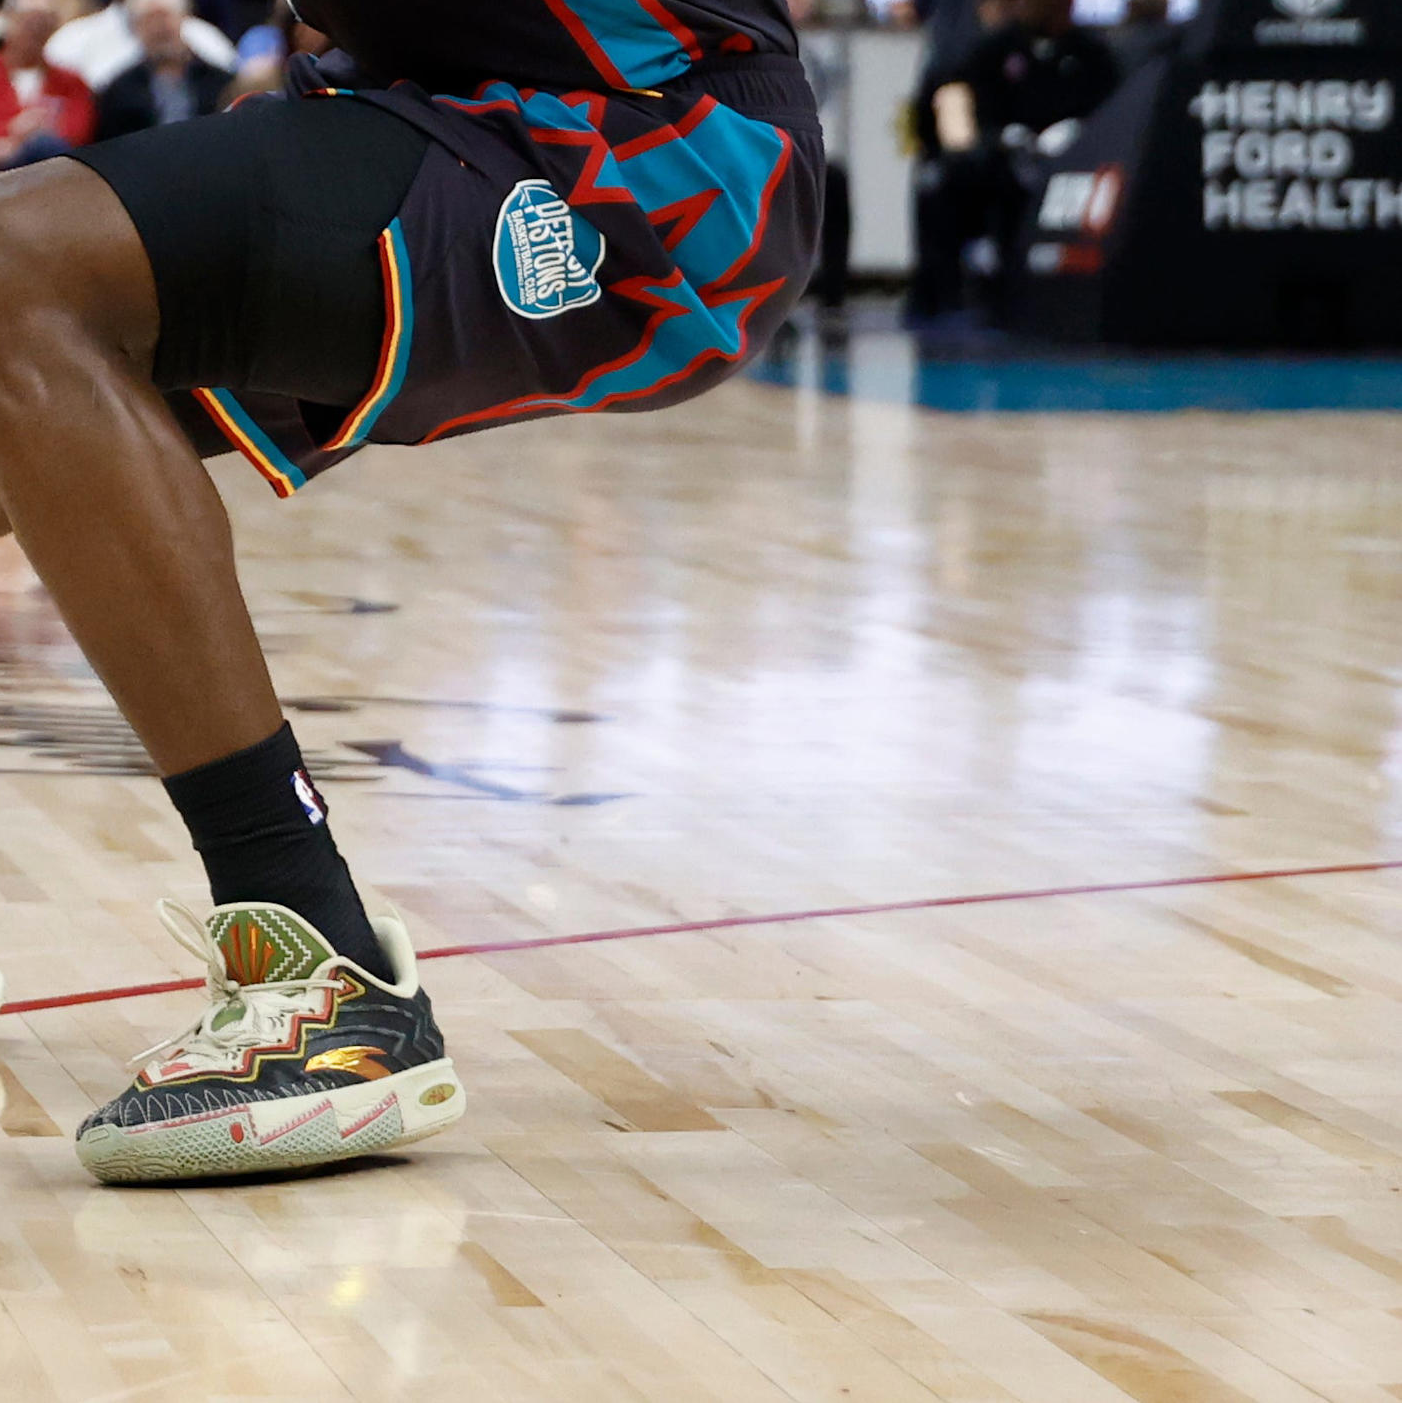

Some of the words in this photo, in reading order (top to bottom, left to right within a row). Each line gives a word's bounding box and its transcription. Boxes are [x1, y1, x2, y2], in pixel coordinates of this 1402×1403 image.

[1200, 80, 1395, 130] HENRY
[1201, 129, 1353, 179] FORD
[511, 209, 535, 279] BASKETBALL
[524, 278, 538, 306] CLUB
